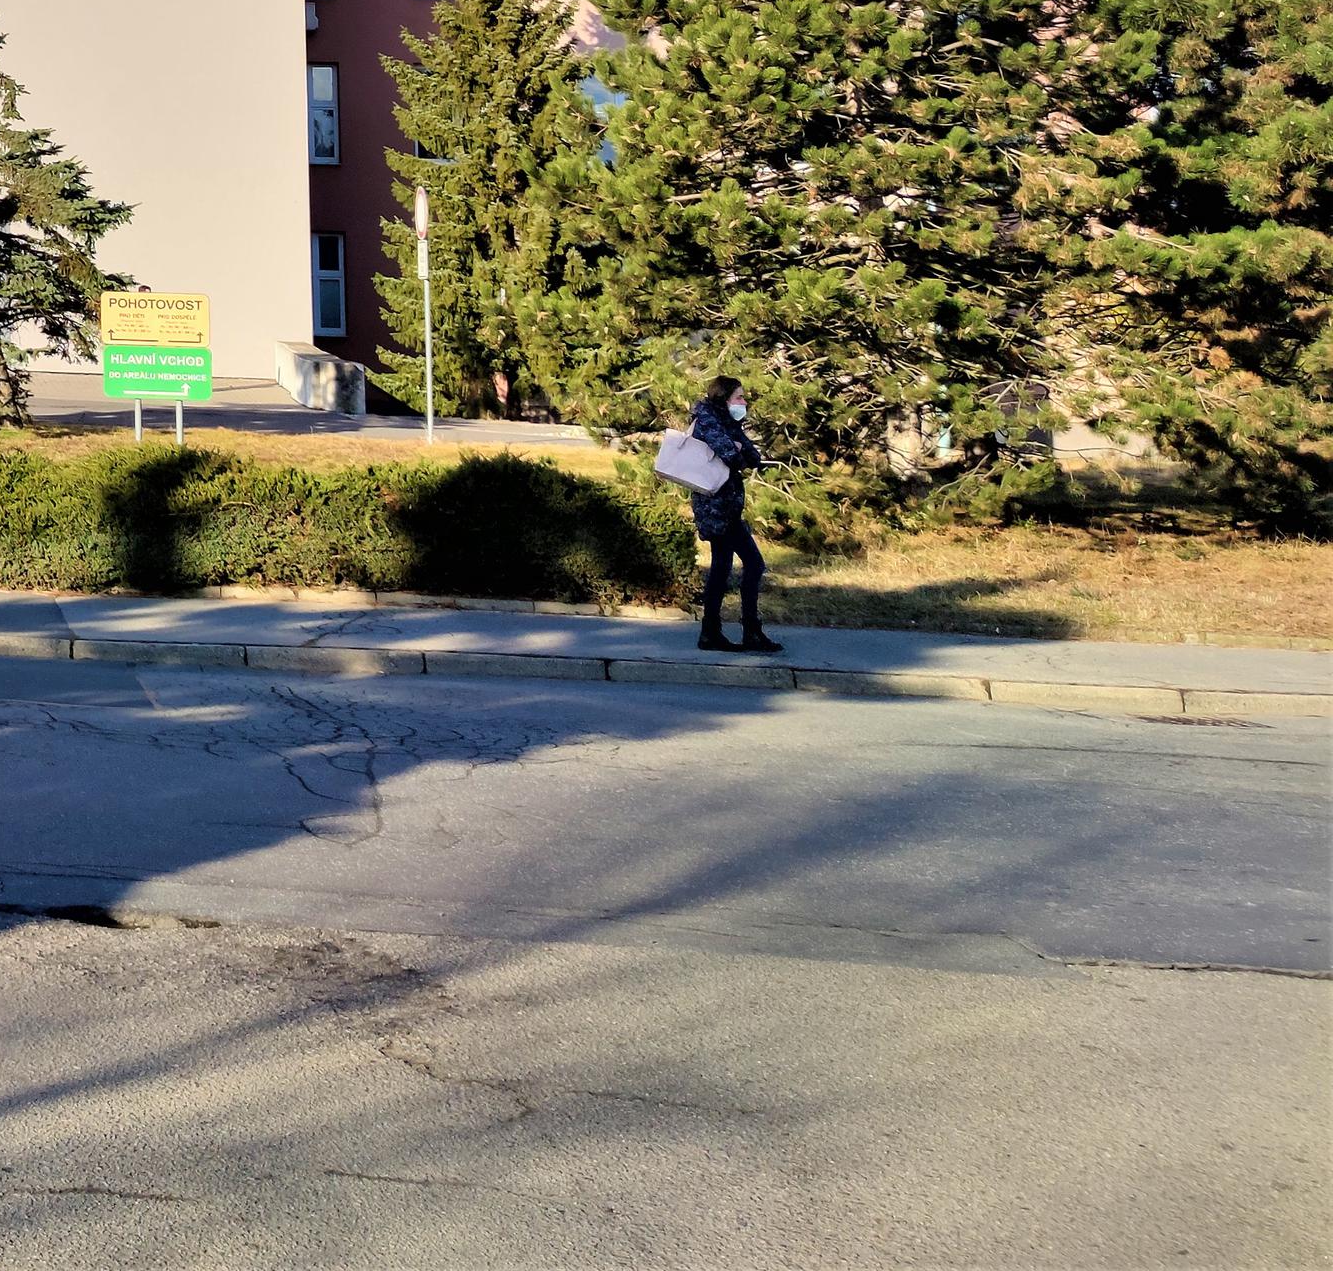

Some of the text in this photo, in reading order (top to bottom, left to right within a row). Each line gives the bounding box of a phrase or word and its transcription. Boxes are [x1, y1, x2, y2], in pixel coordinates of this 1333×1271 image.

[109, 298, 203, 310] POHOTOVOST
[111, 353, 204, 366] HLAVNÍ VCHOD
[158, 373, 206, 381] NEMOCNICE
